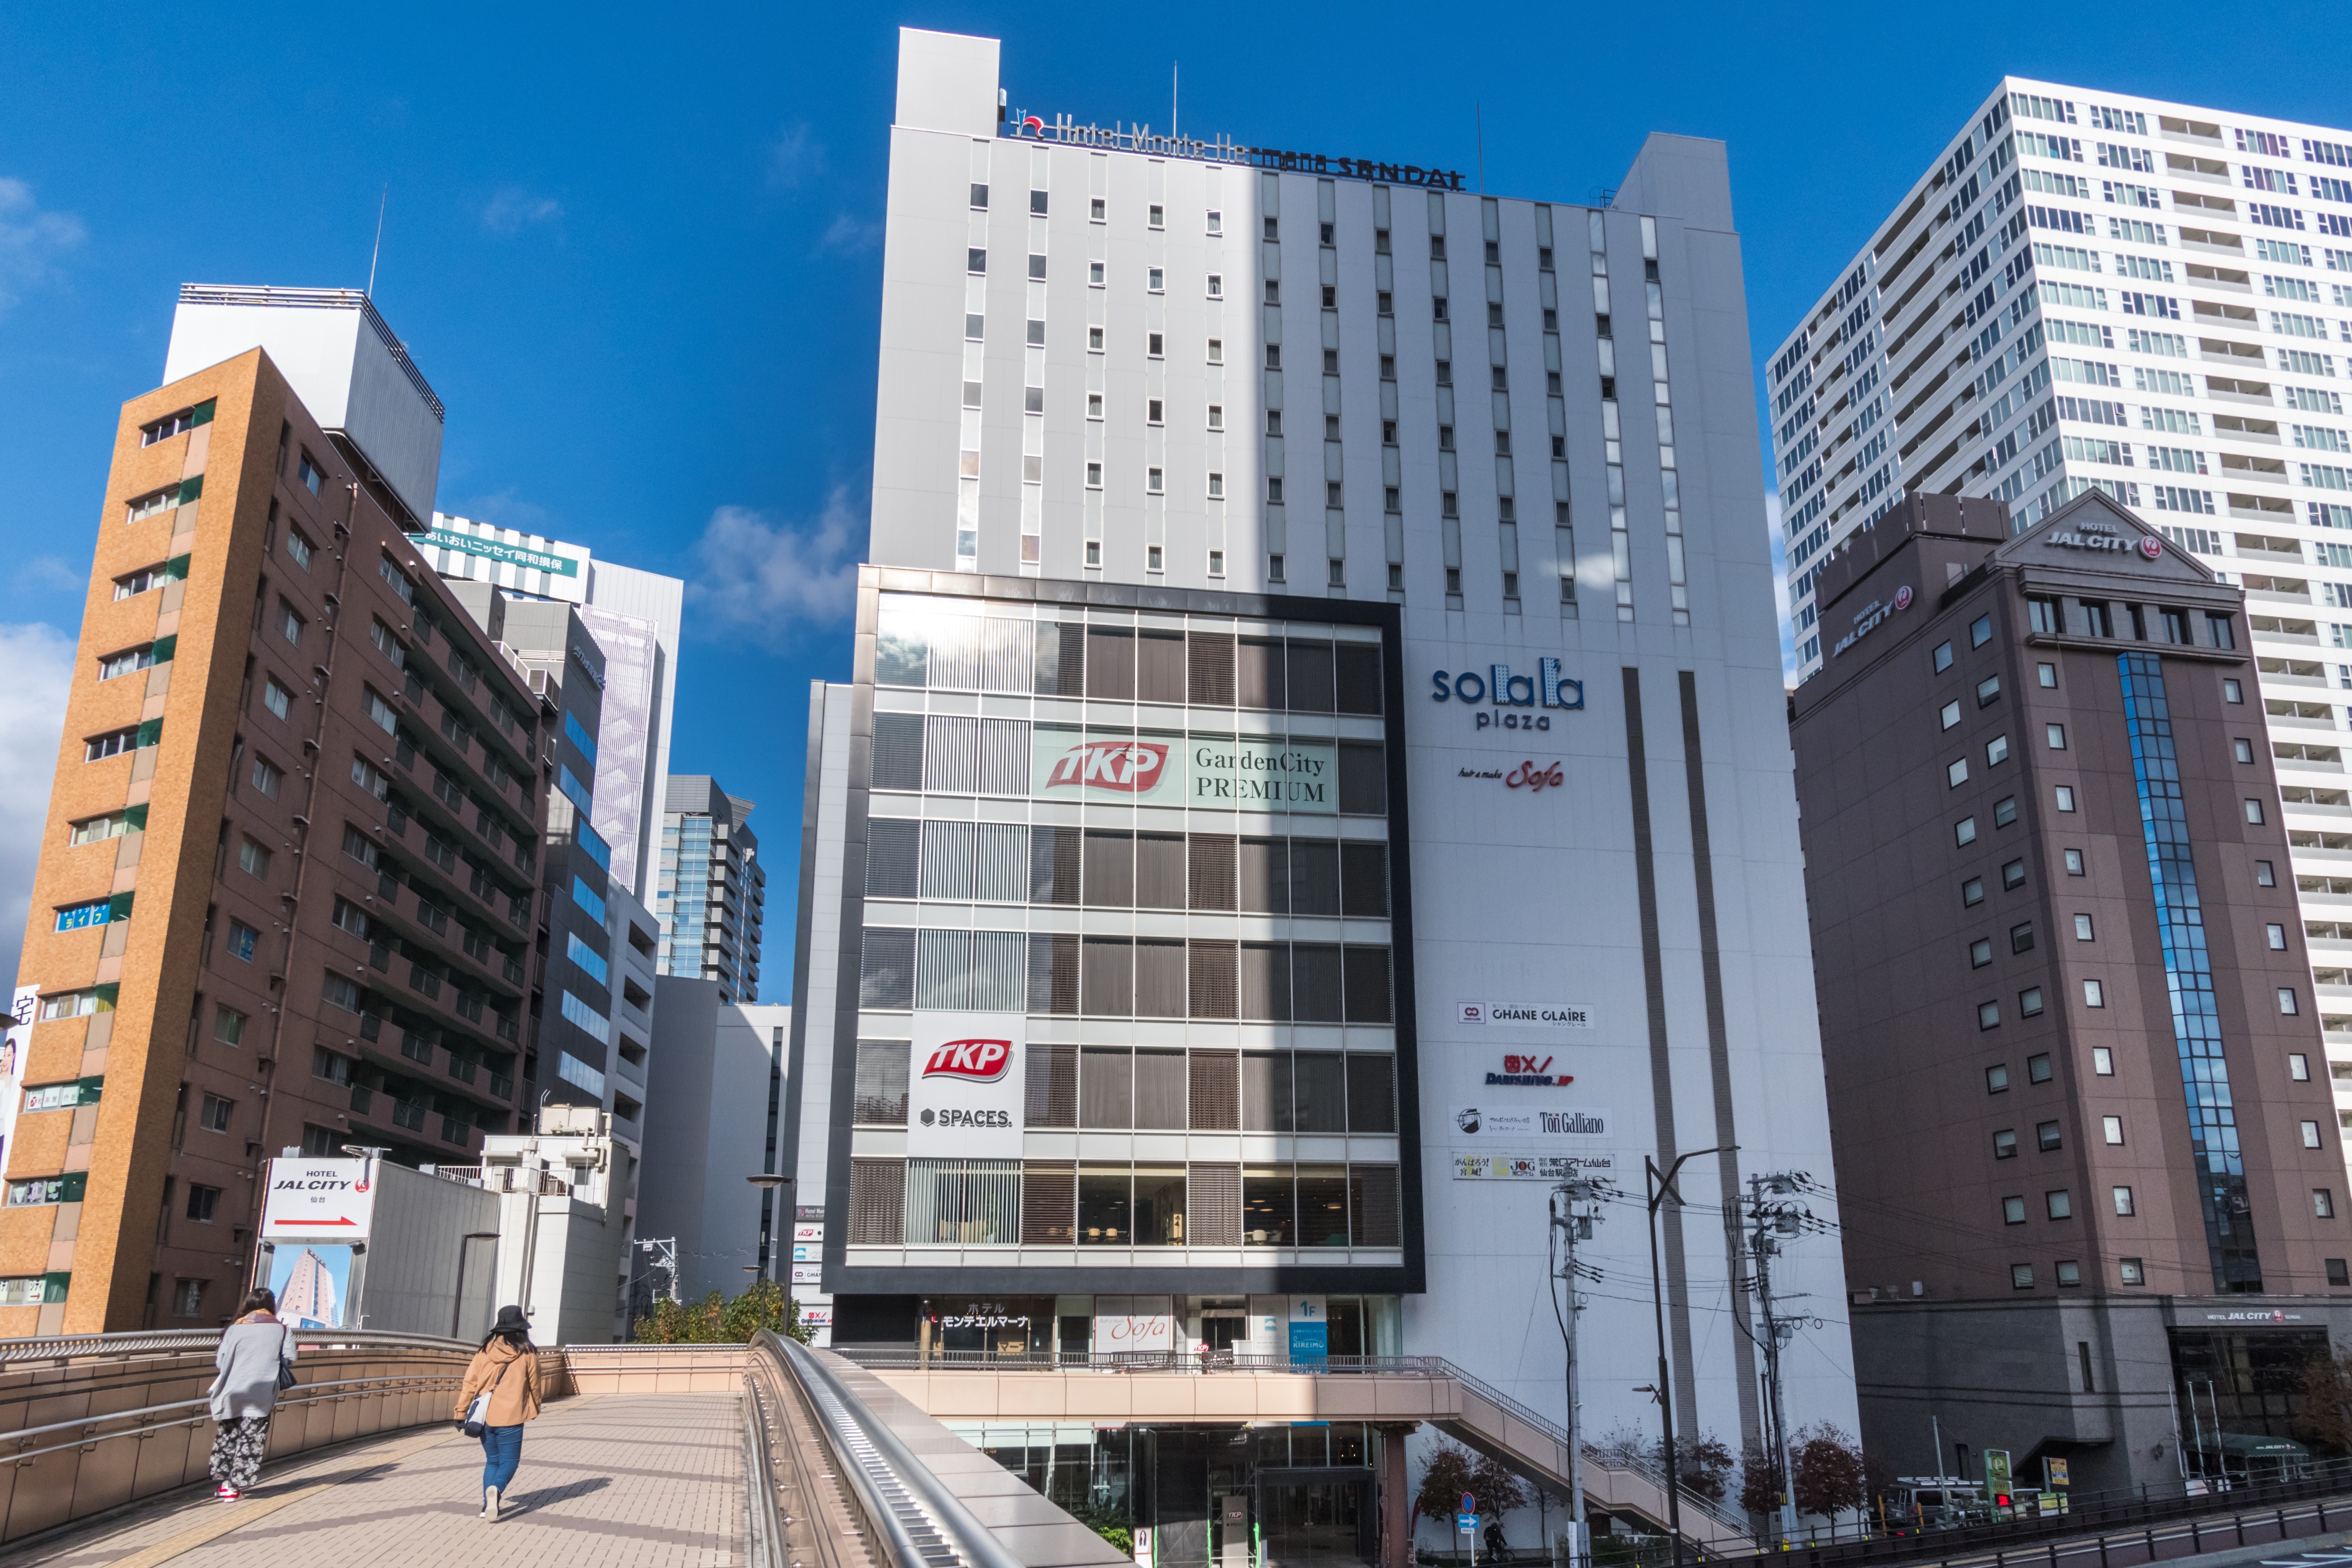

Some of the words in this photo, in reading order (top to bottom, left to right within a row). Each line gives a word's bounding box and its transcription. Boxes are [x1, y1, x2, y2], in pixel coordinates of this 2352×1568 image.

[1057, 113, 1120, 149] Hotel
[1133, 122, 1205, 158] Monte
[1217, 133, 1326, 173] Hermana
[1338, 157, 1458, 190] SENDAI
[2081, 522, 2119, 533] HOTEL
[425, 532, 562, 570] あいおいニッセイ同和損保
[2046, 532, 2085, 546] JAL
[2086, 535, 2137, 551] CITY
[1854, 600, 1882, 624] HOTEL
[1832, 631, 1858, 658] JAL
[1858, 601, 1893, 637] CITY
[1432, 657, 1584, 710] solala
[1476, 710, 1550, 731] plaza
[1062, 746, 1158, 784] TKP
[1458, 768, 1474, 778] hair
[1481, 770, 1502, 779] make
[1506, 760, 1564, 792] Sofa
[1196, 777, 1325, 802] PREMIUM
[14, 995, 34, 1026] 宅
[1493, 1009, 1537, 1020] CHANE
[934, 1043, 1004, 1070] TKP
[1562, 1113, 1603, 1134] Galliano
[1510, 1161, 1535, 1171] JOG
[1540, 1169, 1578, 1177] 仙台駅店
[274, 1181, 304, 1189] JAL
[308, 1181, 352, 1190] CITY
[968, 1303, 1005, 1313] ホテル
[1301, 1301, 1316, 1316] 1F
[943, 1316, 1028, 1327] モンテエルマーナ
[1112, 1312, 1165, 1342] Sofa
[1994, 1459, 2003, 1470] P
